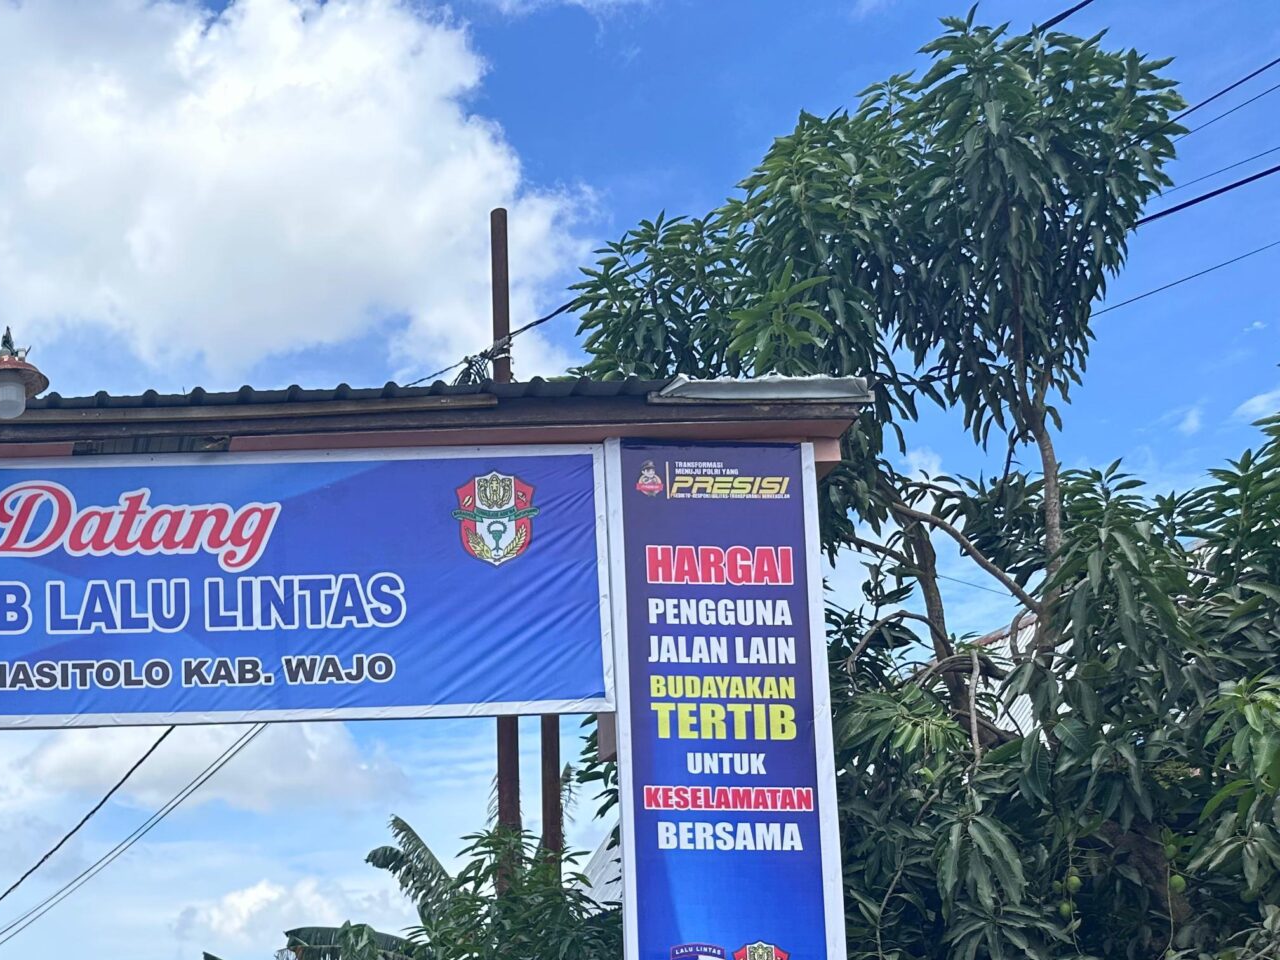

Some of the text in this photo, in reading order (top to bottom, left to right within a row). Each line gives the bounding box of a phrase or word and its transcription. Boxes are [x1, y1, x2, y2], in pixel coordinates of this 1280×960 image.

[670, 476, 790, 494] PRESISI
[645, 545, 795, 586] HARGAI
[46, 577, 192, 635] LALU
[204, 572, 408, 633] LINTAS
[648, 597, 793, 626] PENGGUNA
[648, 635, 796, 665] JALAN LAIN
[182, 657, 274, 687] KAB.
[284, 653, 396, 684] WAJO
[650, 675, 796, 700] BUDAYAKAN
[650, 702, 797, 741] TERTIB
[686, 752, 766, 775] UNTUK
[643, 785, 815, 812] KESELAMATAN
[657, 821, 804, 851] BERSAMA
[675, 947, 721, 955] LALU LINTAS
